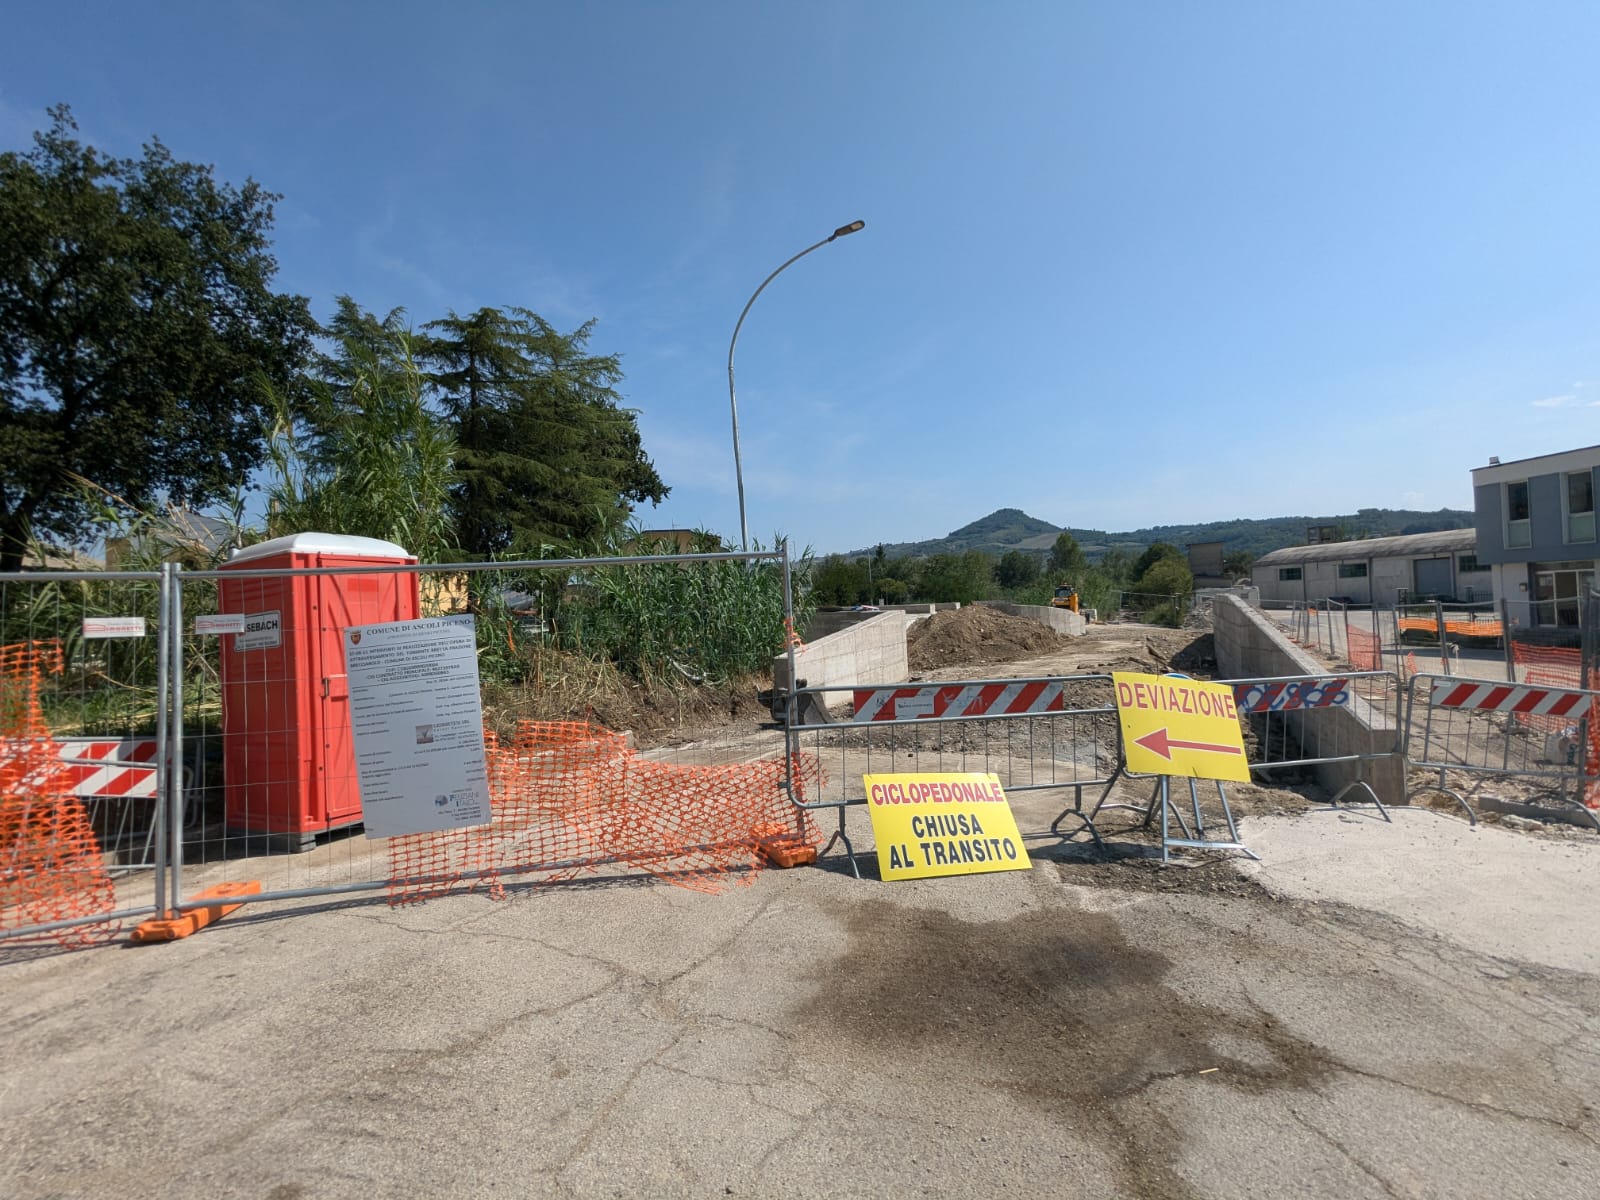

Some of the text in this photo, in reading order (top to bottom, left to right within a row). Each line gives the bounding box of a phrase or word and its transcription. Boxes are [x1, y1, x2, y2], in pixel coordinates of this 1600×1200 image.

[246, 620, 278, 633] SEBACH
[366, 627, 400, 636] COMUNE
[402, 625, 411, 633] DI
[412, 622, 440, 631] ASCOLI
[441, 619, 471, 628] PICENO
[1118, 682, 1237, 720] DEVIAZIONE
[871, 782, 1004, 806] CICLOPEDONALE
[911, 813, 984, 838] CHIUSA
[890, 838, 1017, 869] AL TRANSITO
